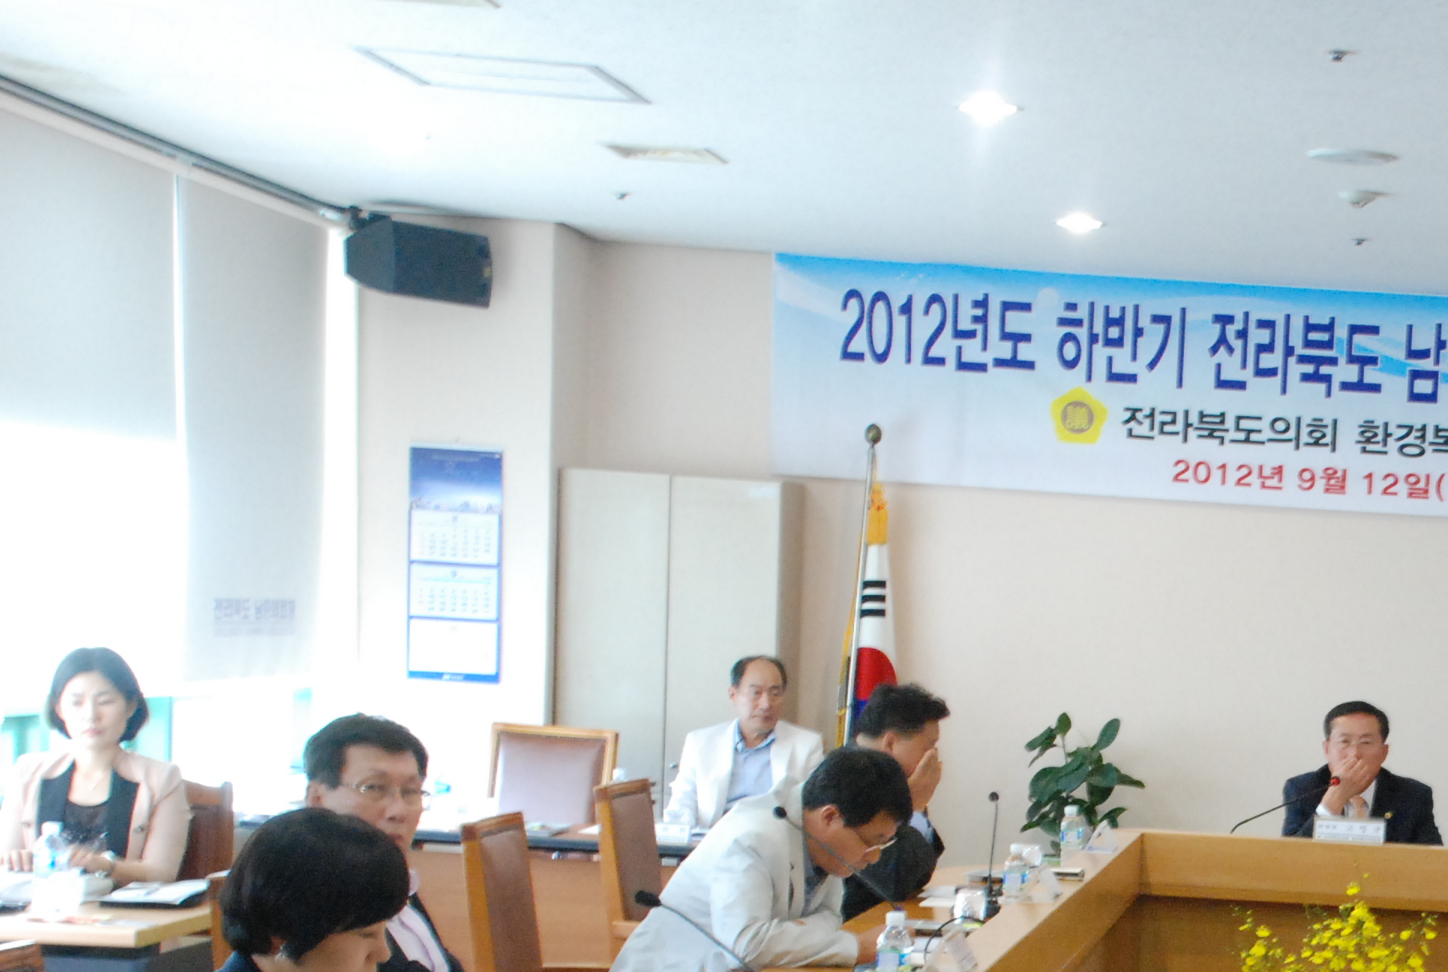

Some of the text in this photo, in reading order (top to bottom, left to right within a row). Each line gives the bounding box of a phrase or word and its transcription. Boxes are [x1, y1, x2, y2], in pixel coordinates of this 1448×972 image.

[841, 289, 1036, 372] 2012년도
[1056, 301, 1187, 389] 하반기
[1209, 309, 1382, 398] 전라북도
[1122, 406, 1338, 453] 전라북도의회
[1173, 458, 1285, 491] 2012년
[1298, 467, 1347, 495] 9월
